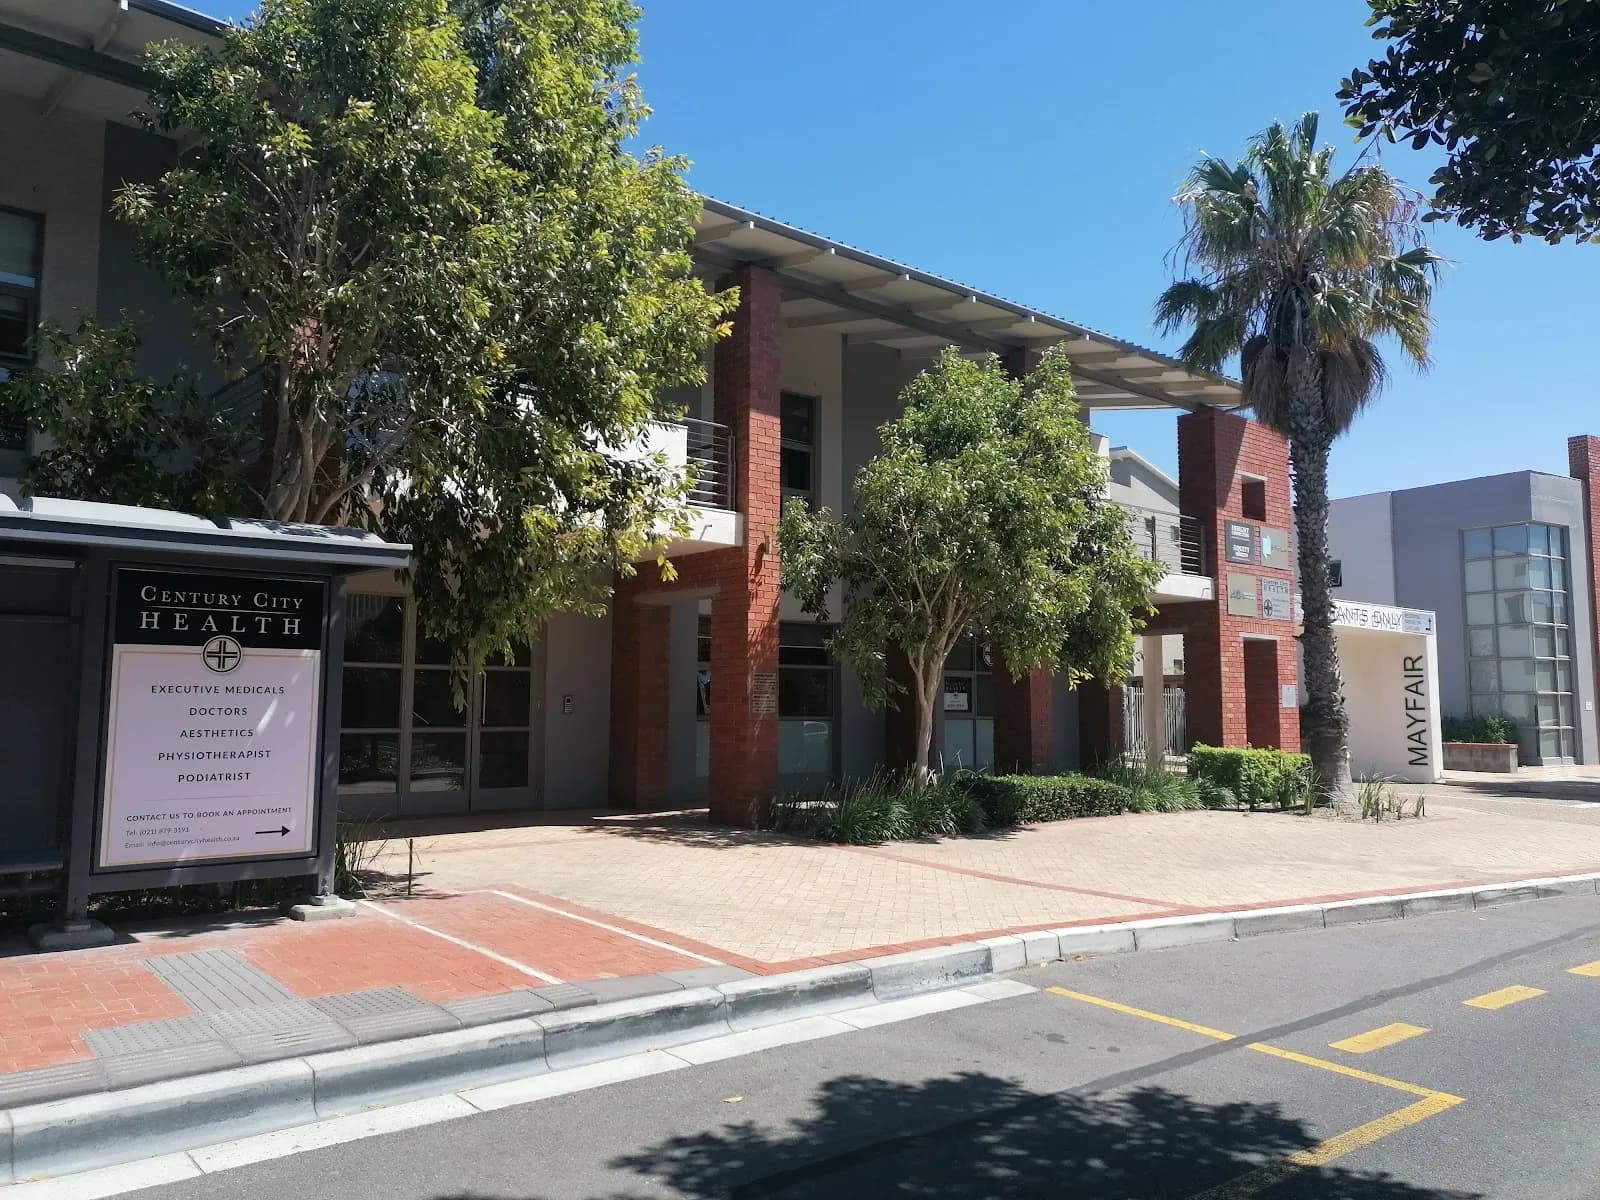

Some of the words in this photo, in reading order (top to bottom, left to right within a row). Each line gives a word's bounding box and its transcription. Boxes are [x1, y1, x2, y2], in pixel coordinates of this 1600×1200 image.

[139, 611, 301, 635] HEALTH
[1373, 610, 1402, 628] ONLY
[151, 685, 220, 694] EXECUTIVE
[225, 686, 285, 694] MEDICALS
[189, 707, 248, 716] DOCTORS
[1403, 654, 1429, 766] MAYFAIR
[180, 729, 254, 738] AESTHETICS
[158, 750, 271, 761] PHYSIOTHERAPIST
[178, 772, 251, 782] PODIATRIST
[126, 813, 167, 822] CONTACT
[169, 812, 180, 820] US
[196, 810, 220, 818] BOOK
[236, 807, 293, 816] APPOINTMENT
